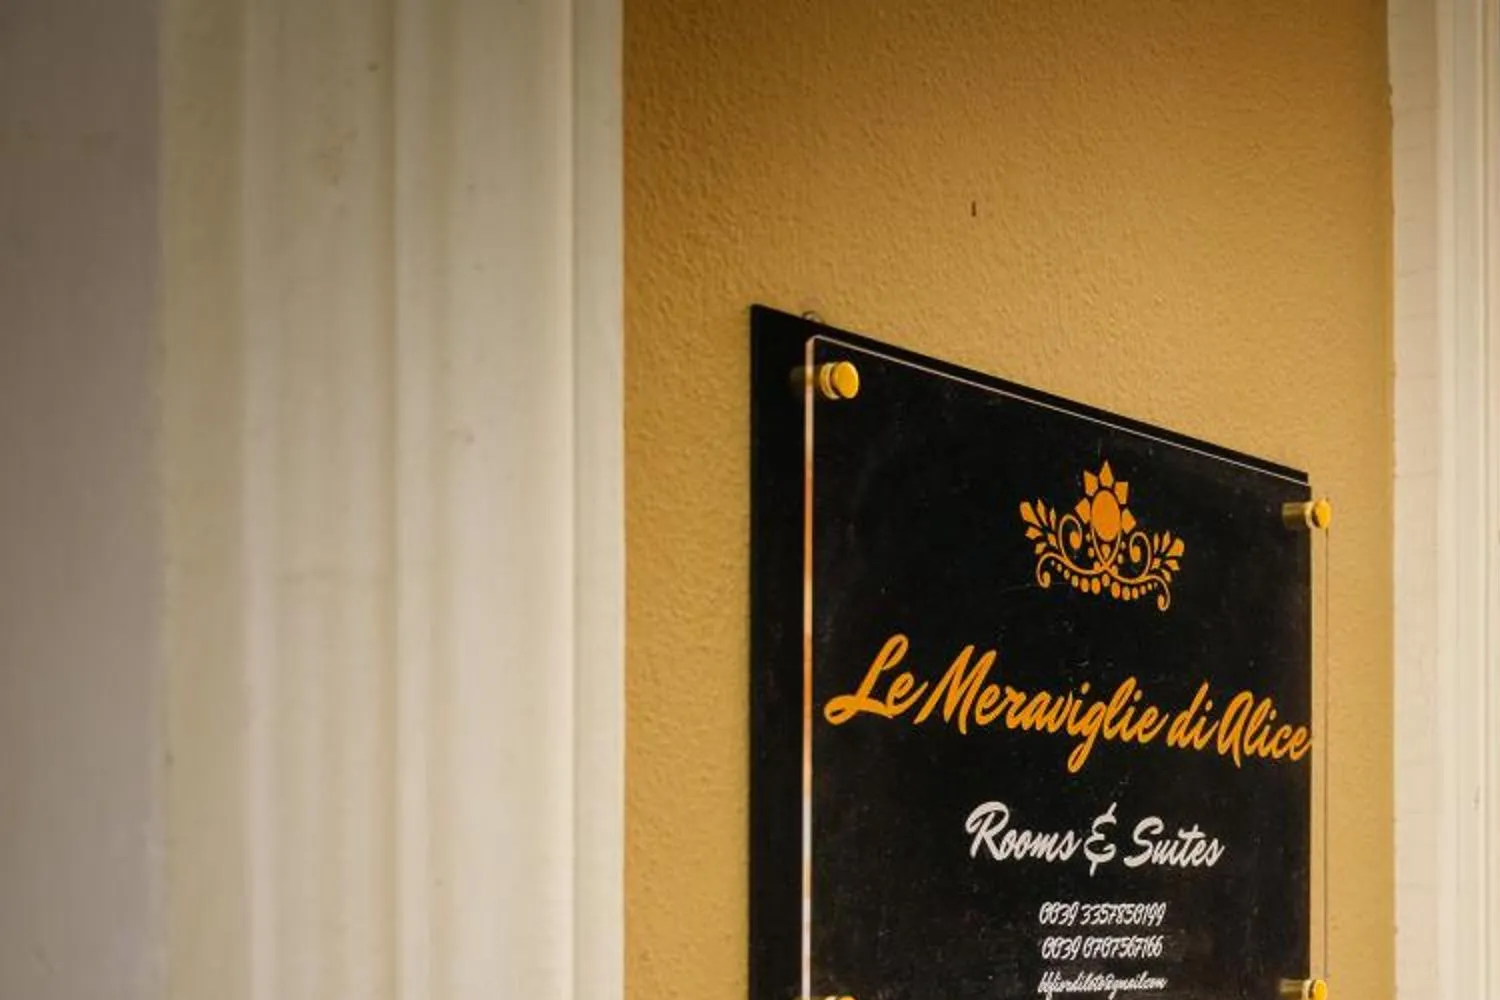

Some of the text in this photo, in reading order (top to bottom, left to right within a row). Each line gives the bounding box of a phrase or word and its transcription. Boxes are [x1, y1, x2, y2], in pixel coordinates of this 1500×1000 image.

[823, 633, 1314, 774] Le Meraviglie di Alice
[964, 801, 1226, 877] Rooms & Suites
[1038, 901, 1080, 926] 0039
[1041, 935, 1082, 960] 0039
